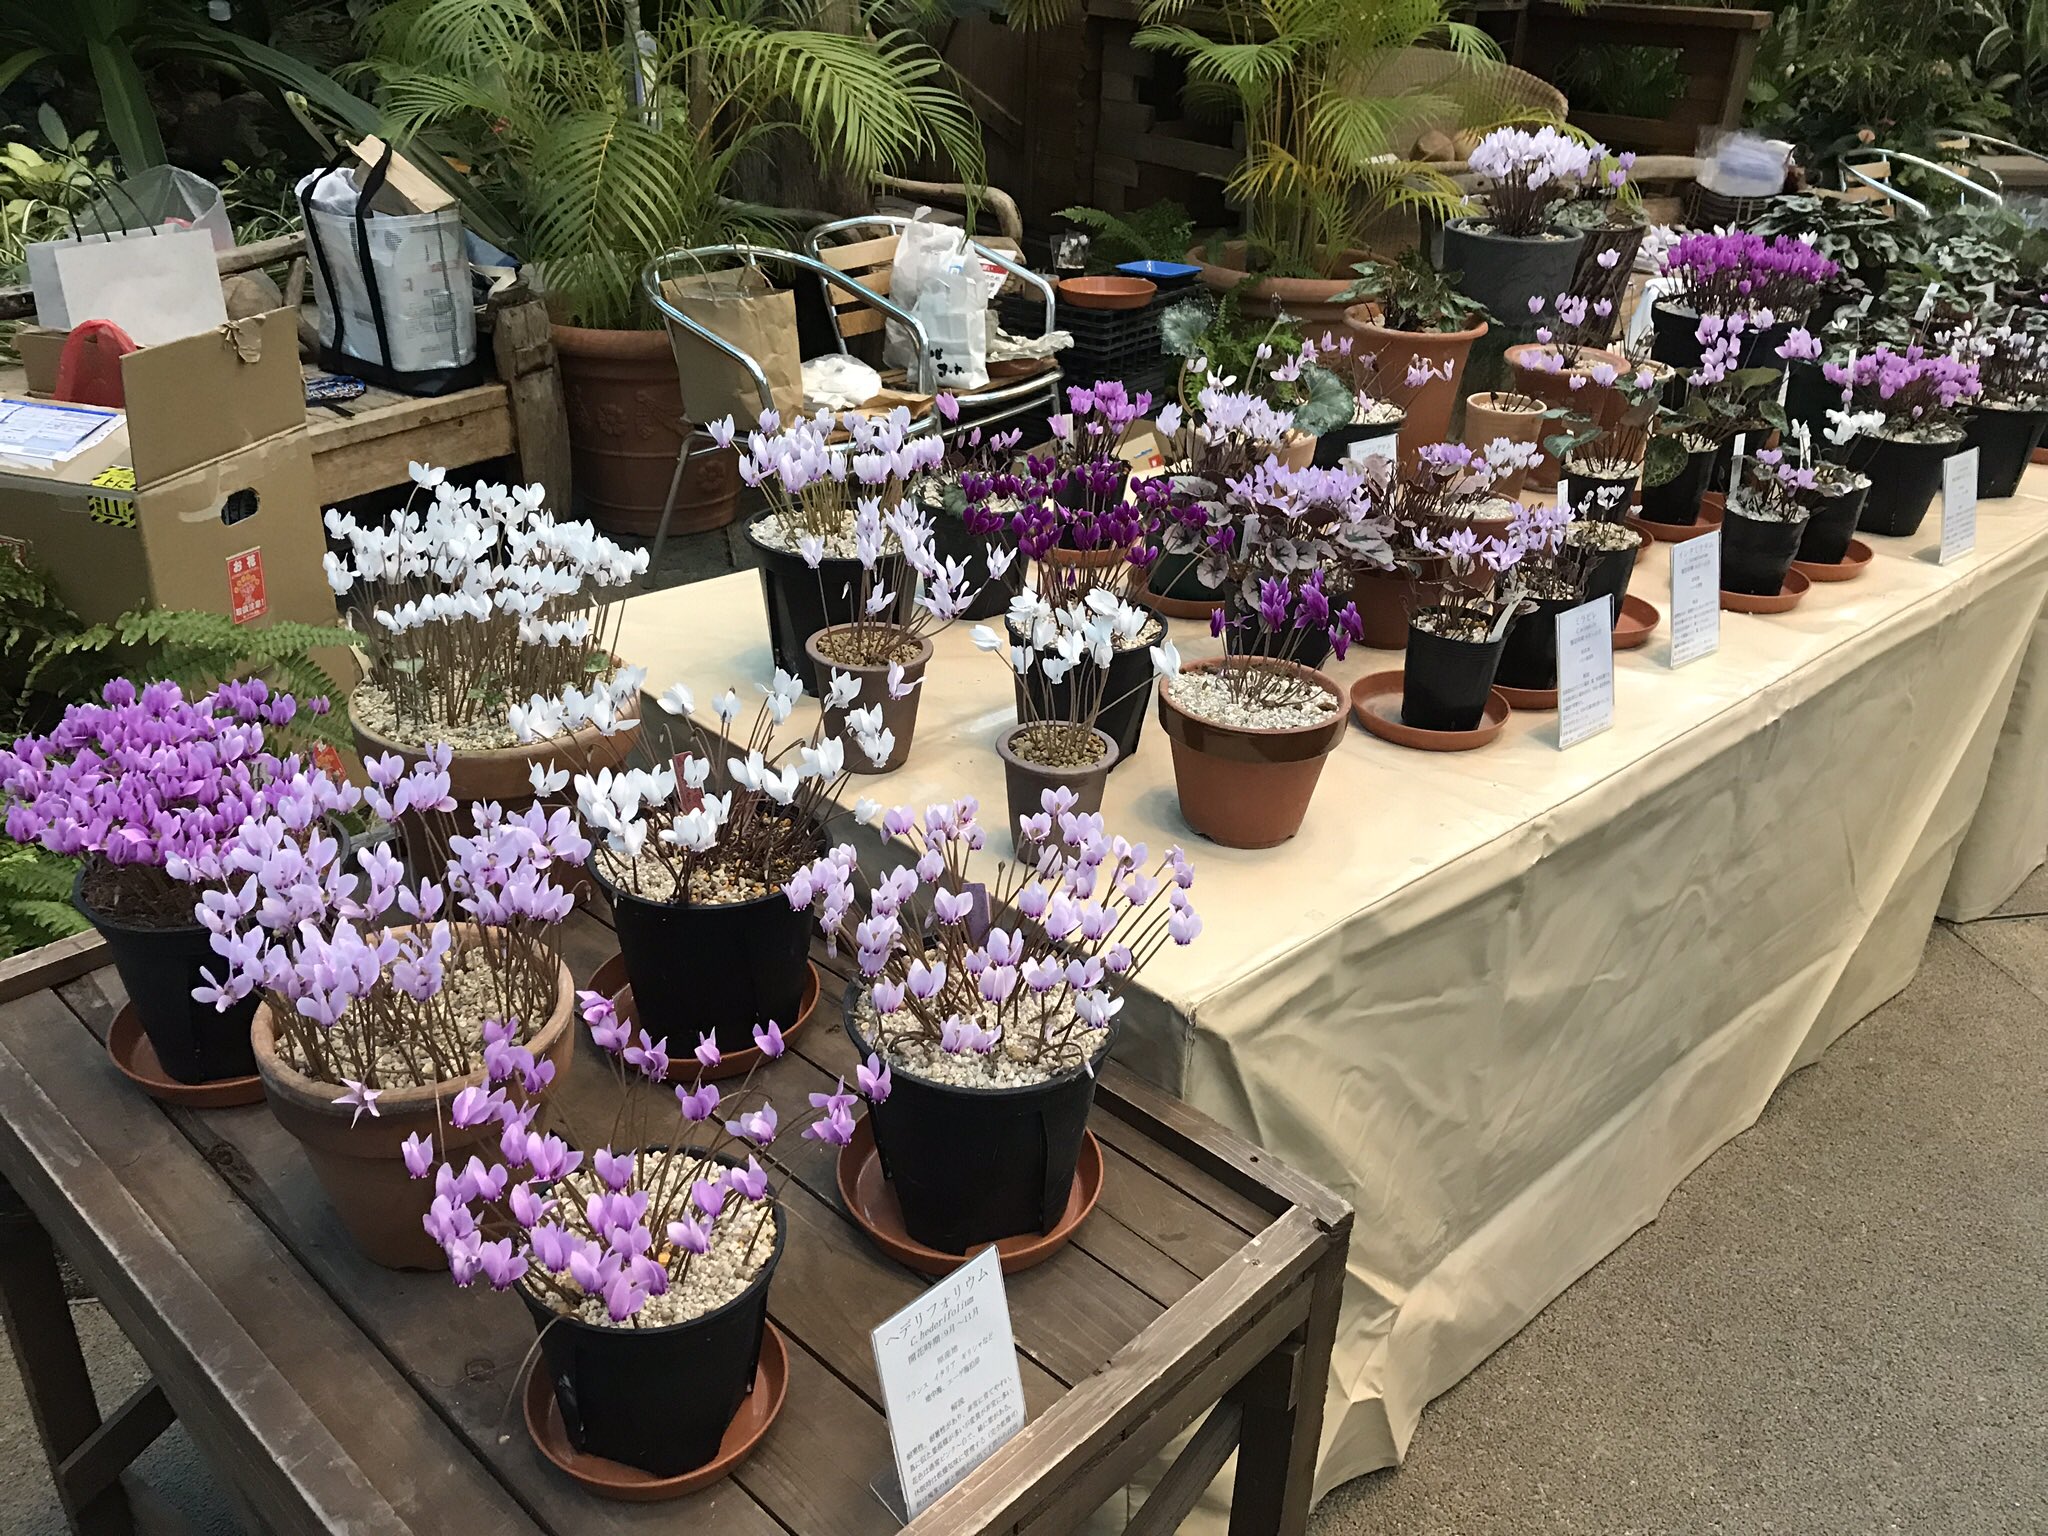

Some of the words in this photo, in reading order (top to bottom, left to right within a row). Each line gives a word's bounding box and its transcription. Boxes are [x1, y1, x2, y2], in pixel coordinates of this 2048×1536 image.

[885, 1268, 989, 1346] ヘデリフォリウム
